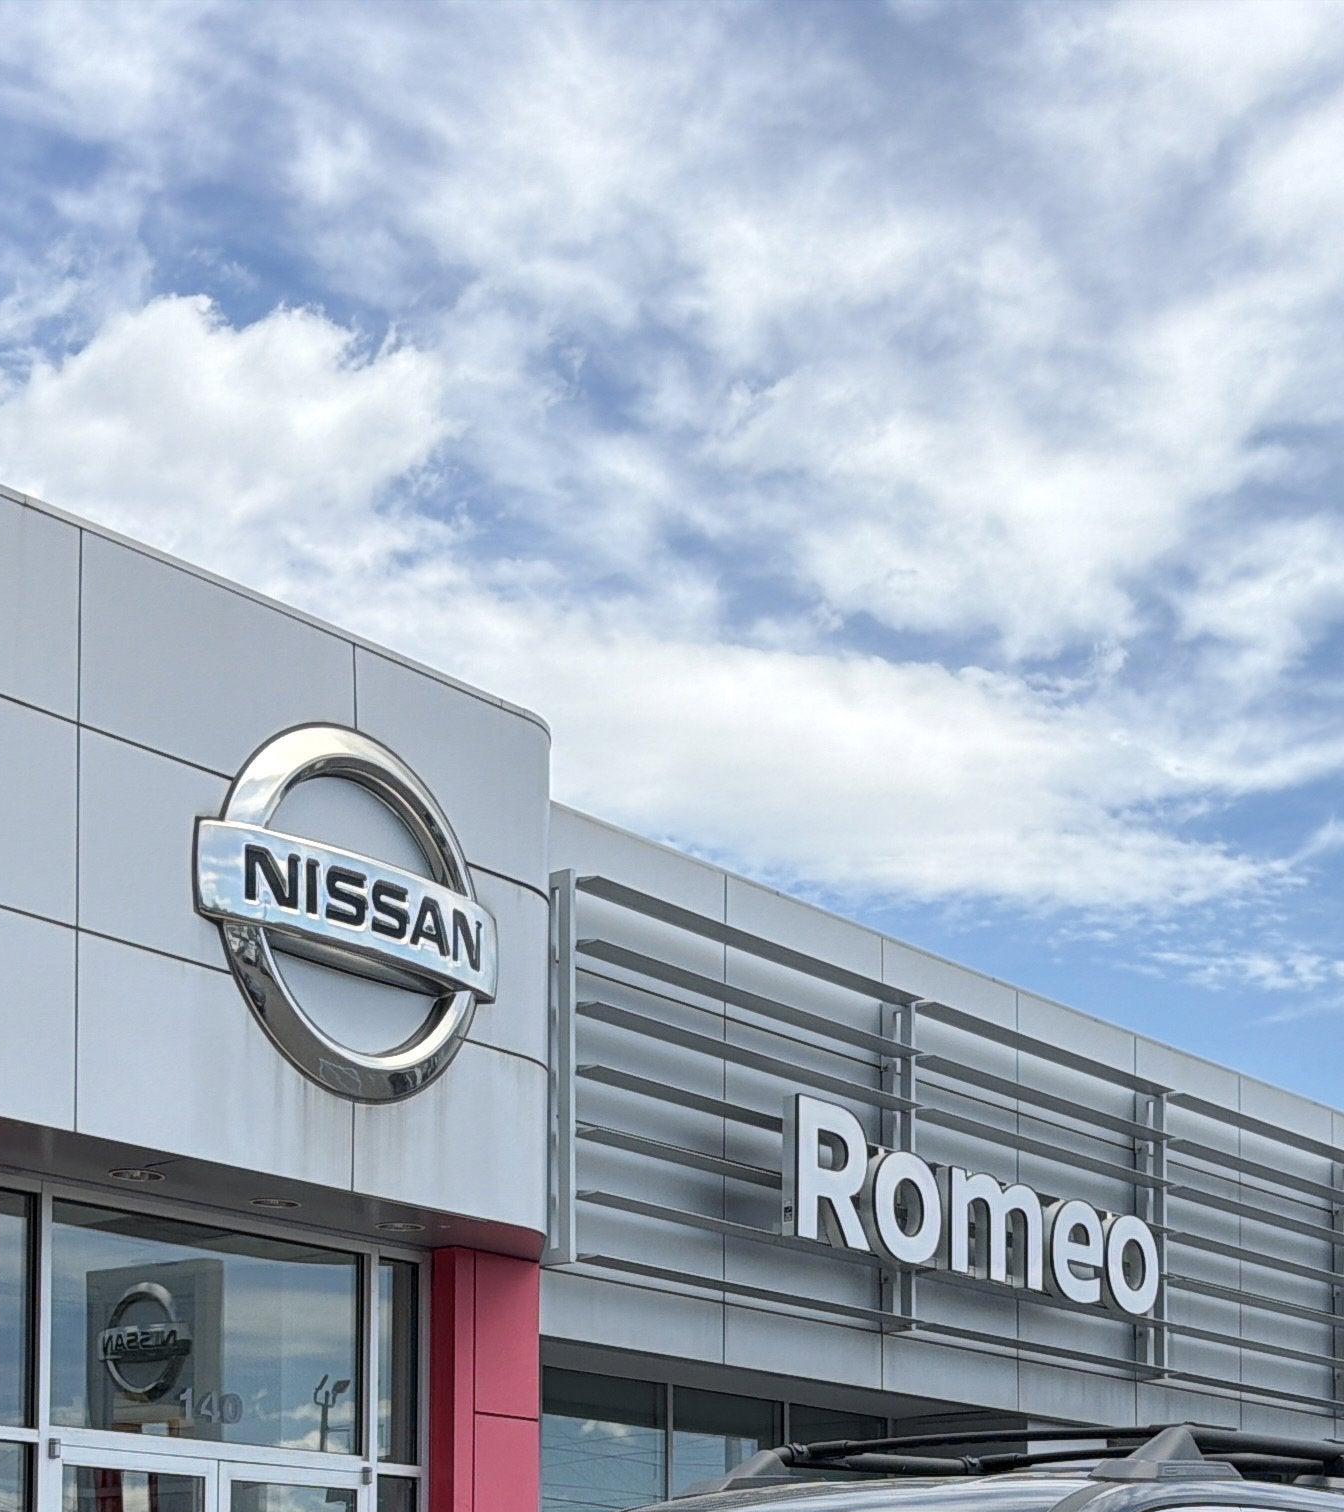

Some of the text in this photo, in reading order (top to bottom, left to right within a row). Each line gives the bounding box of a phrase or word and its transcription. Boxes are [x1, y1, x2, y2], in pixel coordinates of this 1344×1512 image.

[242, 843, 482, 973] NISSAN
[792, 1093, 1159, 1315] Romeo
[179, 1387, 243, 1424] 140
